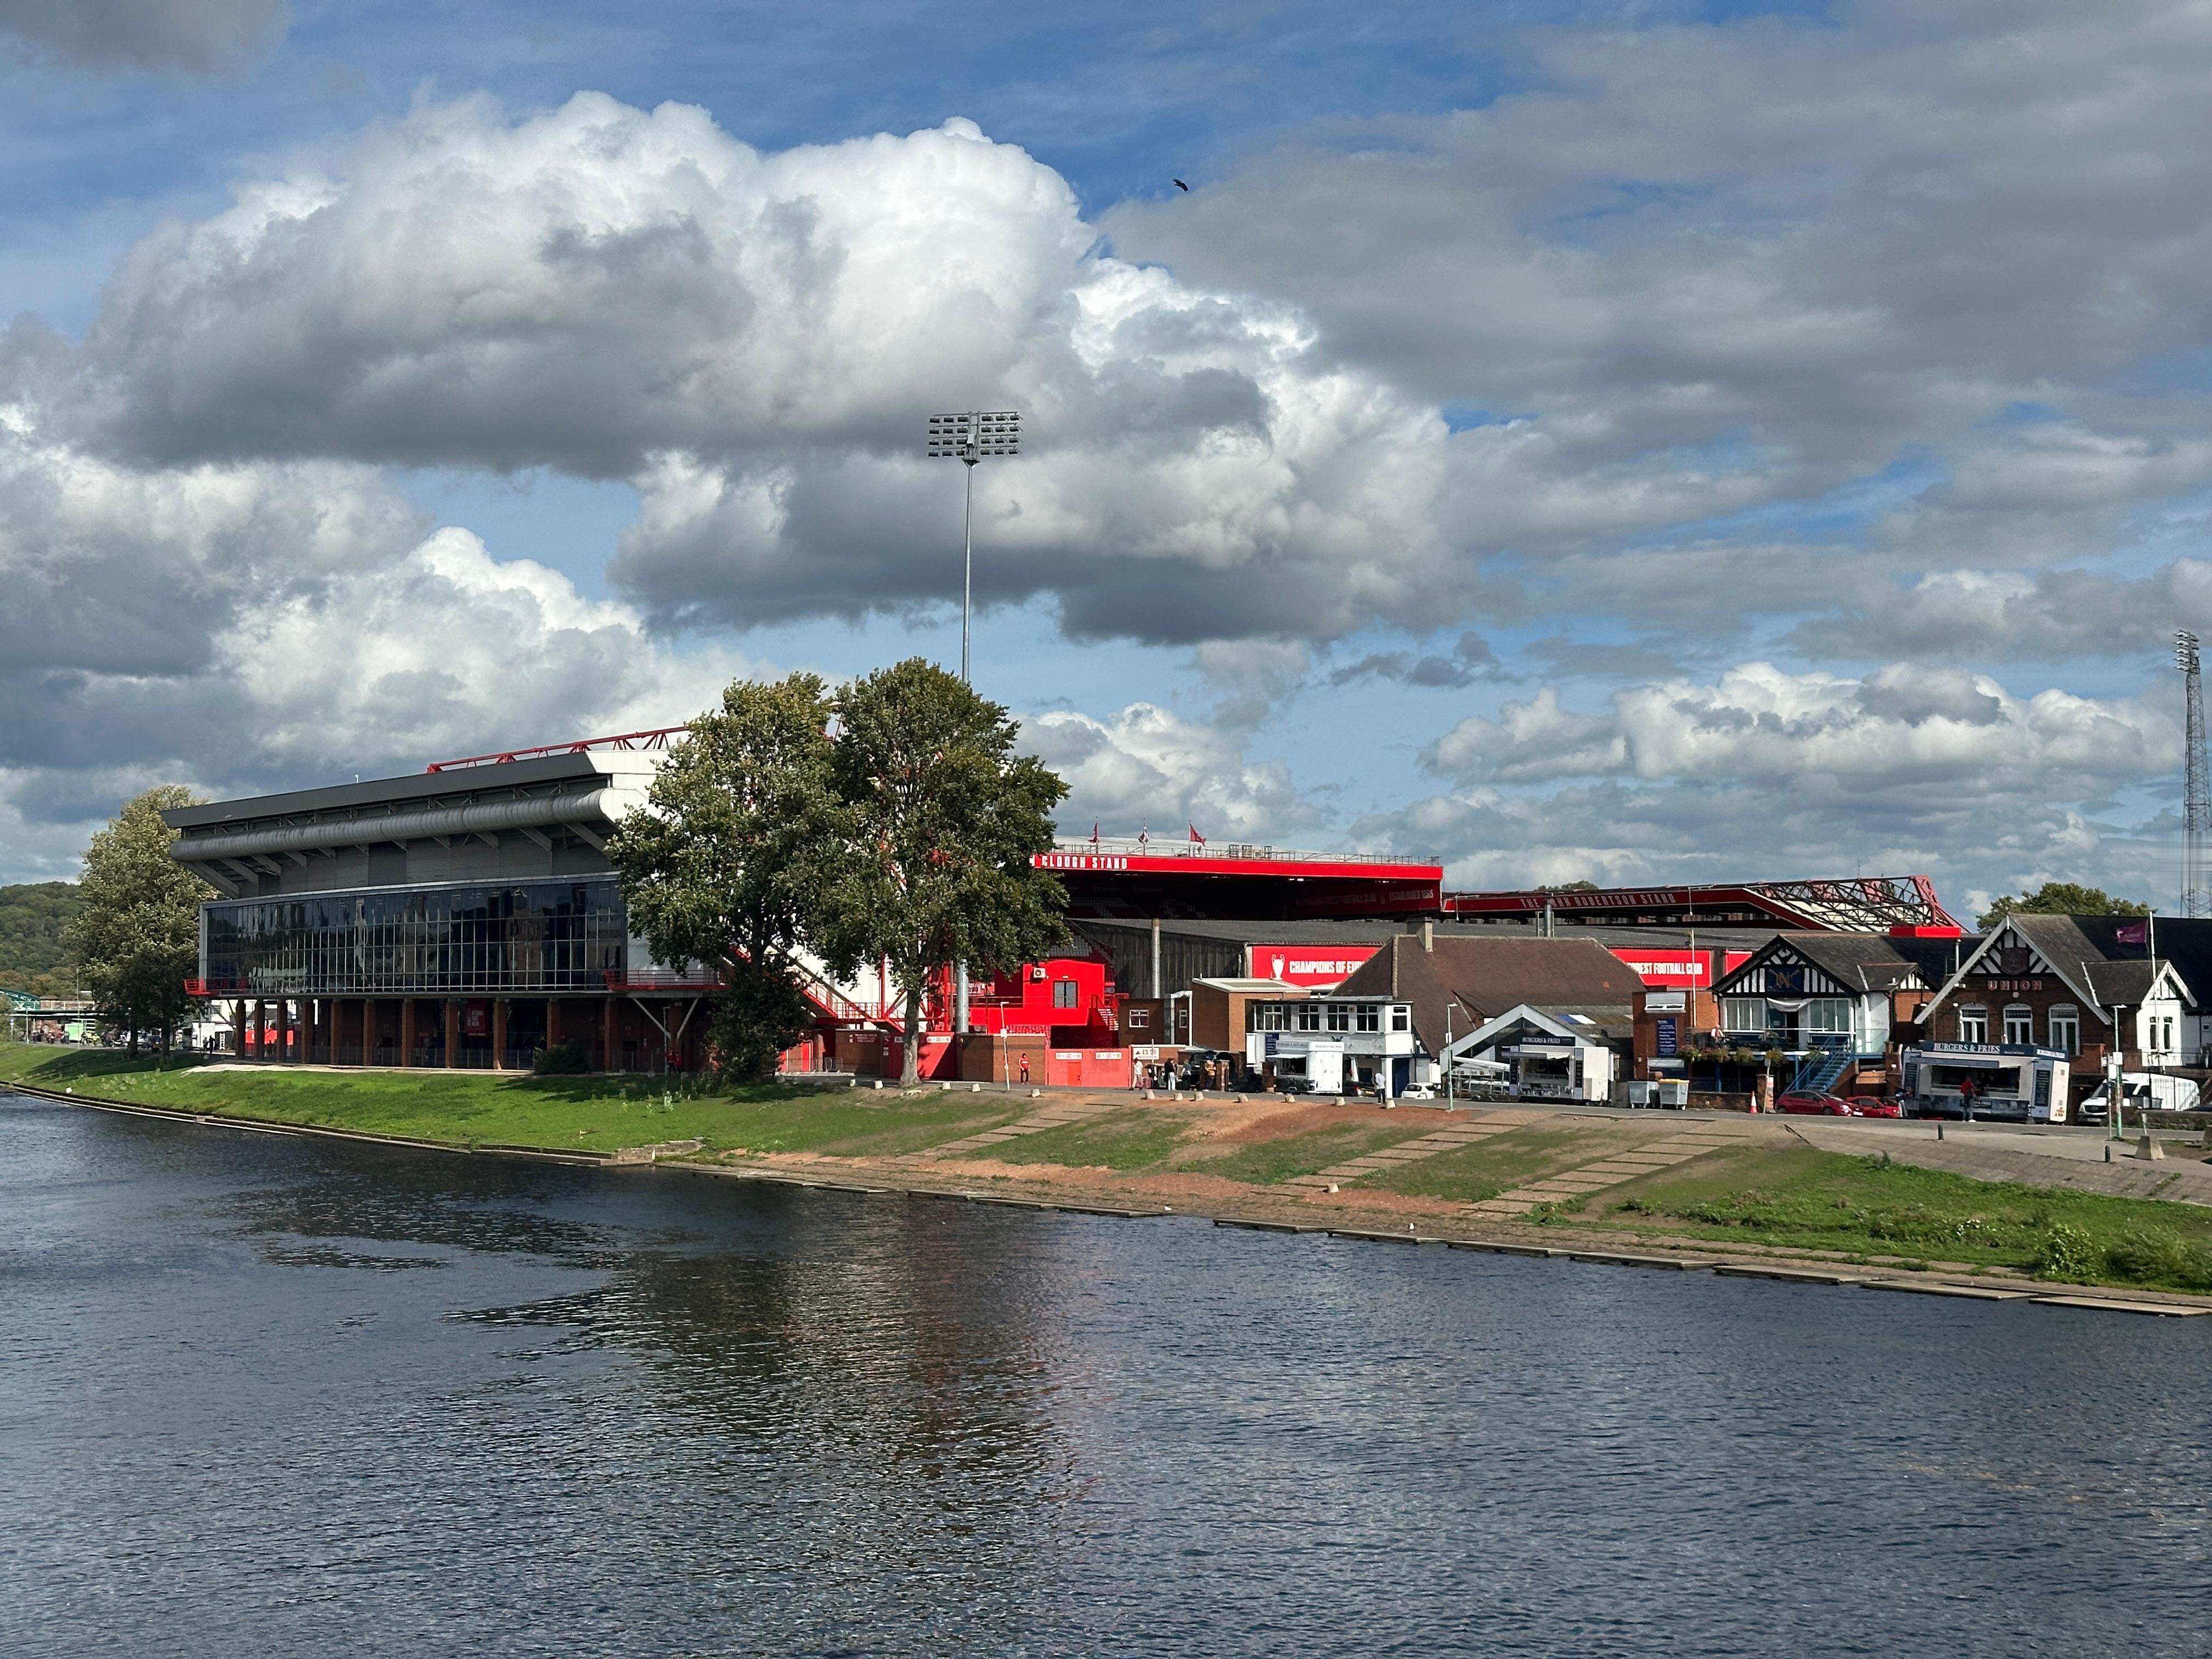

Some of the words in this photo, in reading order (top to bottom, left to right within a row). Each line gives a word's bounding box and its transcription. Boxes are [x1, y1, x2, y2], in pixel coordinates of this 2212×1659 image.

[1042, 855, 1086, 868] CLOUGH
[1092, 856, 1127, 870] STAND
[1520, 898, 1540, 908] THE
[1547, 897, 1571, 907] OHN
[1575, 894, 1637, 906] ROBERTSON
[1640, 893, 1676, 905] STAND
[1289, 961, 1335, 973] CHAMPIONS
[1335, 961, 1346, 973] OF
[1653, 962, 1685, 975] FOOTBALL
[1686, 963, 1703, 975] CLUB
[1988, 980, 2042, 990] UNION
[1933, 1042, 1968, 1052] BURGERS
[1970, 1044, 1976, 1052] &
[1977, 1045, 2000, 1053] FRIES
